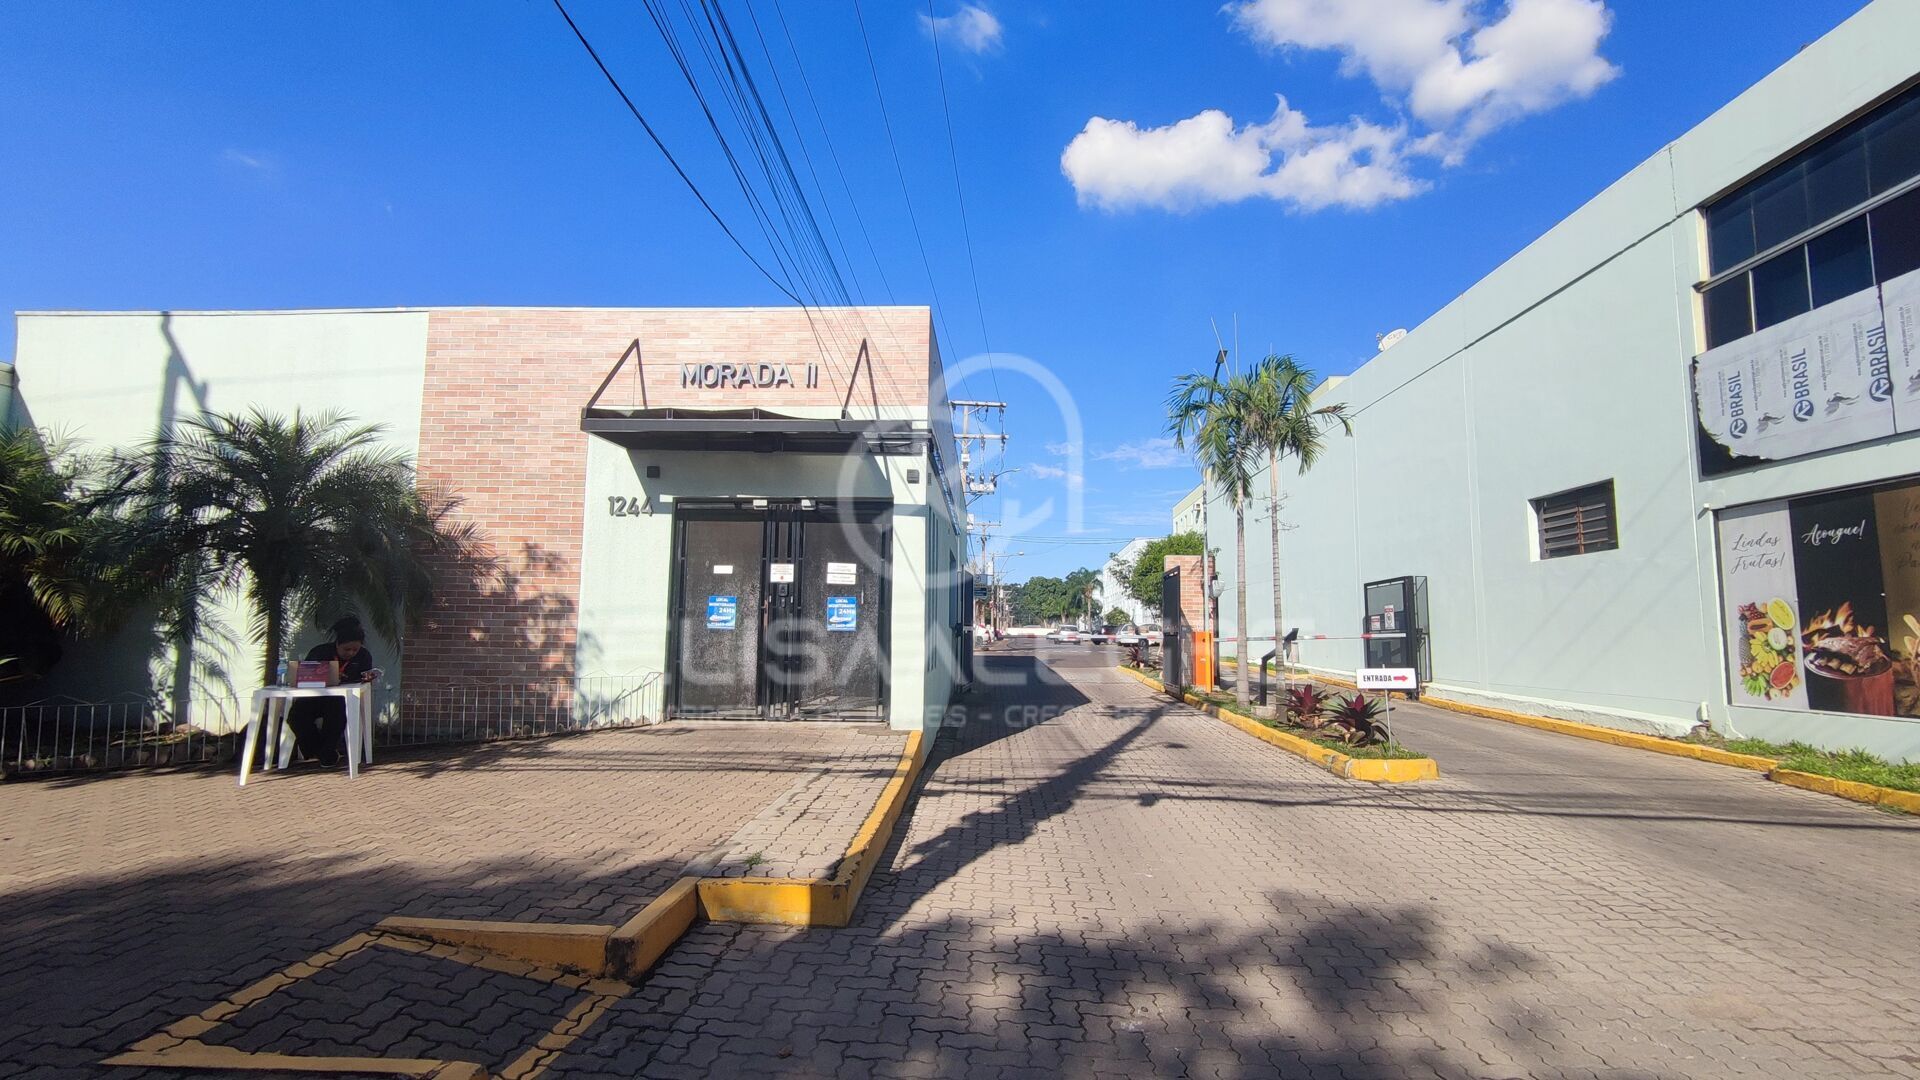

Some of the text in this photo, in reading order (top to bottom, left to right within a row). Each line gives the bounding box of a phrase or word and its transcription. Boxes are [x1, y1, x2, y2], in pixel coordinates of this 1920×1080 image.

[1866, 320, 1890, 377] BRASIL
[680, 362, 794, 388] MORADA
[1790, 348, 1810, 399] BRASIL
[1727, 370, 1745, 418] BRASIL
[608, 496, 654, 517] 1244
[1731, 530, 1781, 553] Lindas
[1801, 519, 1866, 547] Açougue!
[1730, 551, 1785, 574] Frutas!
[1363, 674, 1392, 682] ENTRADA
